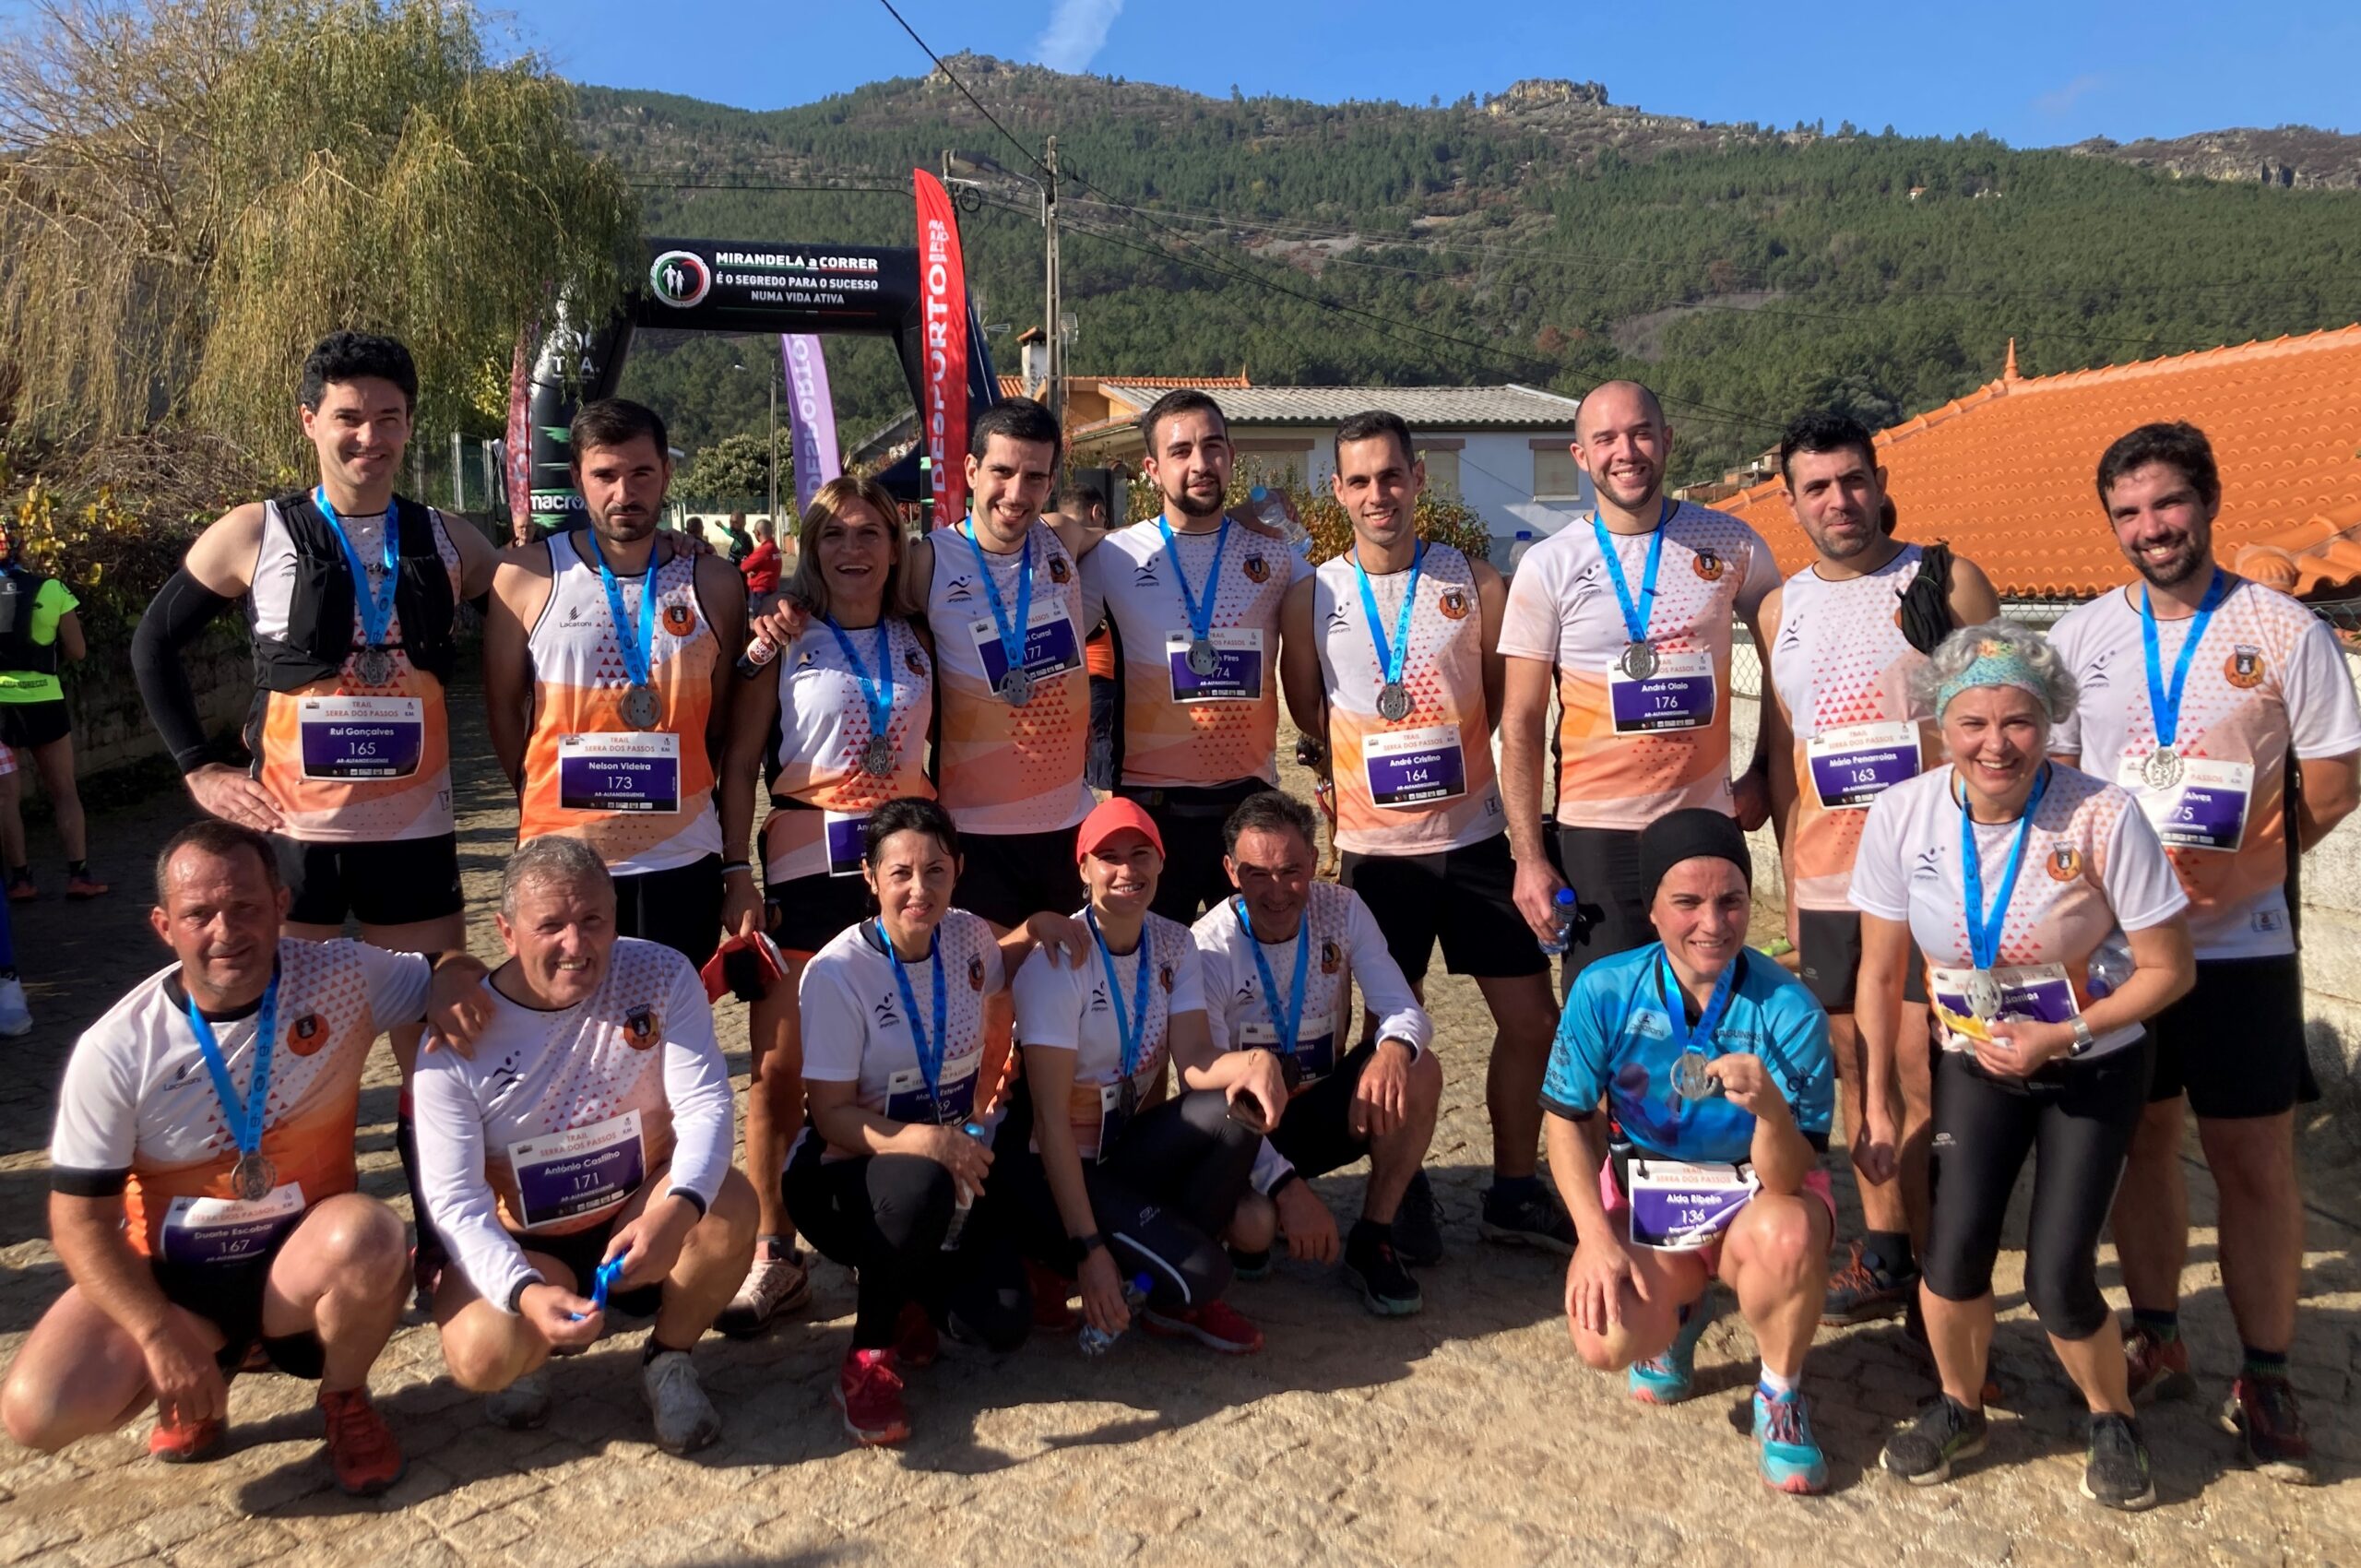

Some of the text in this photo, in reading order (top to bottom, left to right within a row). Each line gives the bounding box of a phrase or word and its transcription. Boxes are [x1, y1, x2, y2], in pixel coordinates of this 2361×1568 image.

[716, 252, 878, 269] MIRANDELA a CORRER
[716, 273, 879, 290] É O SEGREDO PARA O SUCESSO
[752, 291, 845, 304] NUMA VIDA ATIVA
[530, 495, 586, 510] macro
[1031, 628, 1052, 640] Curral
[1224, 654, 1240, 662] Pires
[1642, 683, 1666, 692] André
[1655, 695, 1678, 708] 176
[346, 728, 394, 737] Gonçalves
[1383, 743, 1402, 752] SERRA
[1419, 738, 1442, 747] PASSOS
[1866, 736, 1894, 744] PASSOS
[350, 742, 376, 754] 165
[589, 762, 651, 770] Nelson Videira
[1390, 754, 1441, 767] André Cristino
[1830, 757, 1851, 767] Mário
[1406, 768, 1428, 782] 164
[1852, 768, 1876, 782] 163
[2190, 774, 2223, 782] PASSOS
[608, 776, 633, 790] 173
[2184, 791, 2212, 802] Alves
[2005, 992, 2039, 1004] Santos
[566, 1133, 588, 1142] TRAIL
[540, 1146, 565, 1157] SERRA
[568, 1142, 585, 1152] DOS
[587, 1132, 616, 1146] PASSOS
[544, 1150, 620, 1176] António Castilho
[573, 1171, 599, 1190] 171
[1667, 1194, 1689, 1205] Alda
[221, 1212, 240, 1220] DOS
[242, 1206, 276, 1218] PASSOS
[1681, 1208, 1706, 1225] 136
[195, 1223, 273, 1240] Duarte Escobar
[220, 1239, 251, 1253] 167
